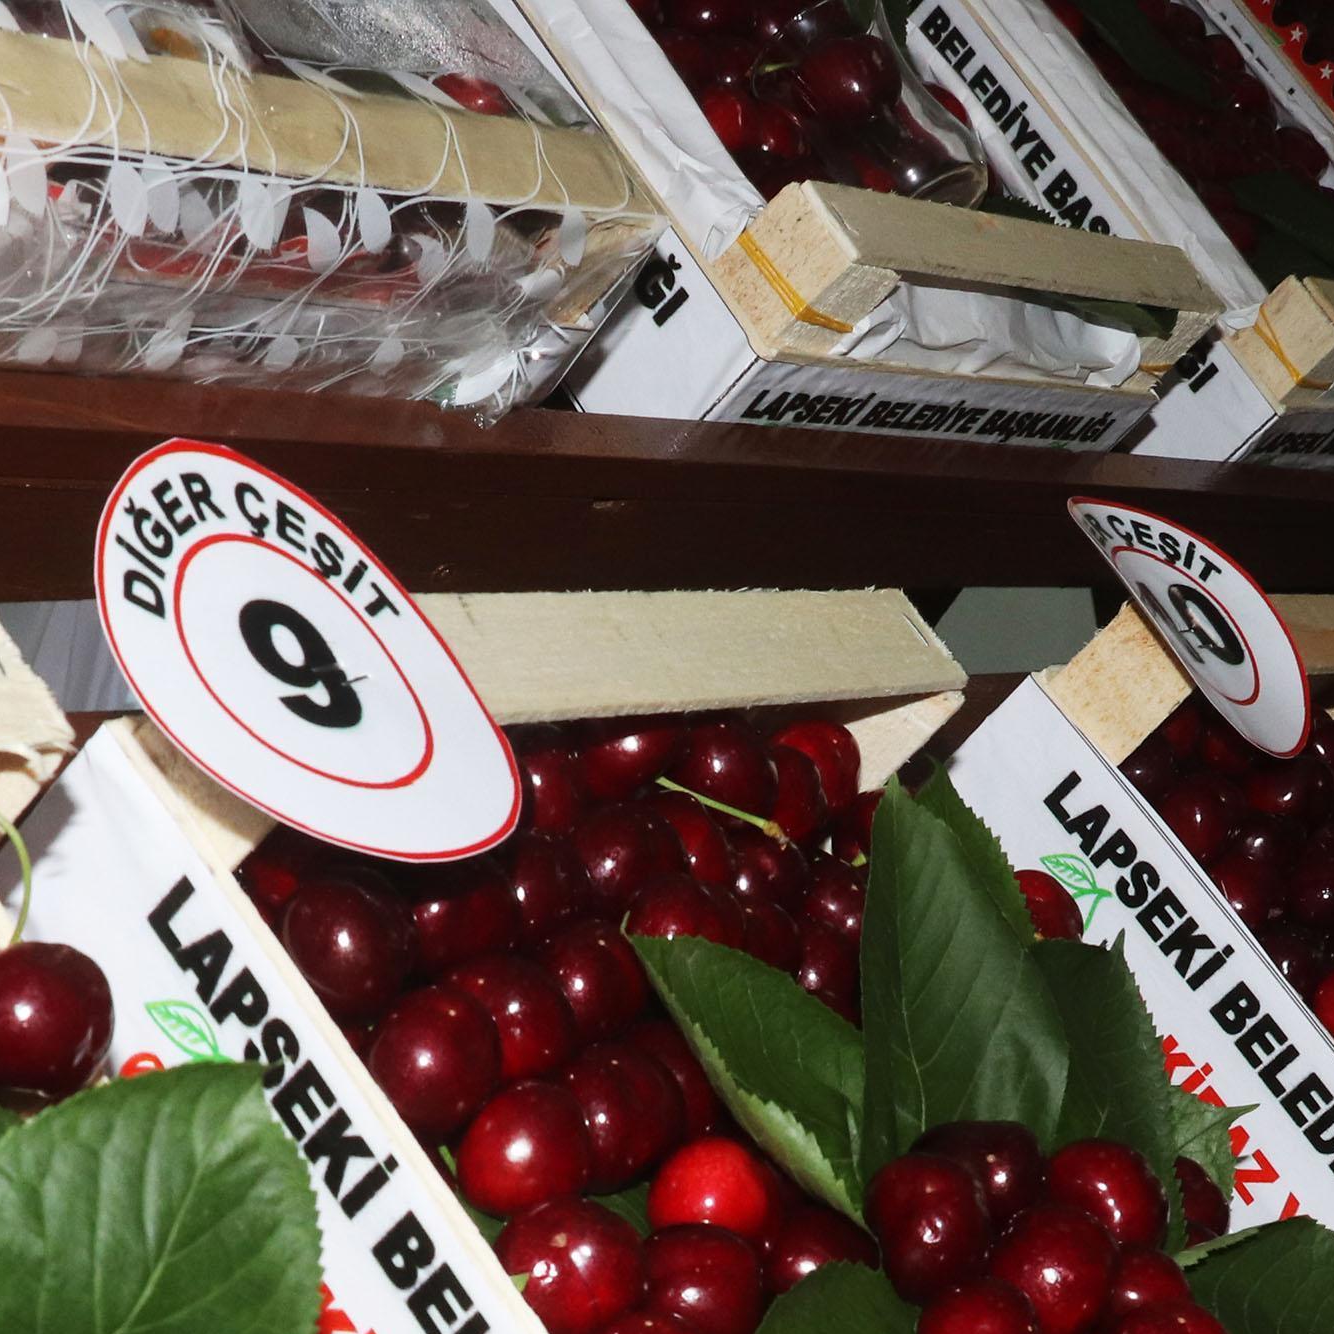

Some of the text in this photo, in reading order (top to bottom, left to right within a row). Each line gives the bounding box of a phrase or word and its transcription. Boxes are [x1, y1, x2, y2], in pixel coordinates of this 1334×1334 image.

[918, 4, 1056, 182] BELEDİYE
[740, 389, 1116, 444] LAPSEKİ BELEDİYE BAŞKANLIĞI
[115, 472, 401, 620] DİĞER ÇEŞİT
[1106, 514, 1223, 583] ÇEŞİT
[238, 597, 363, 730] 9
[1042, 770, 1236, 992] LAPSEKİ
[146, 875, 399, 1221] LAPSEKİ
